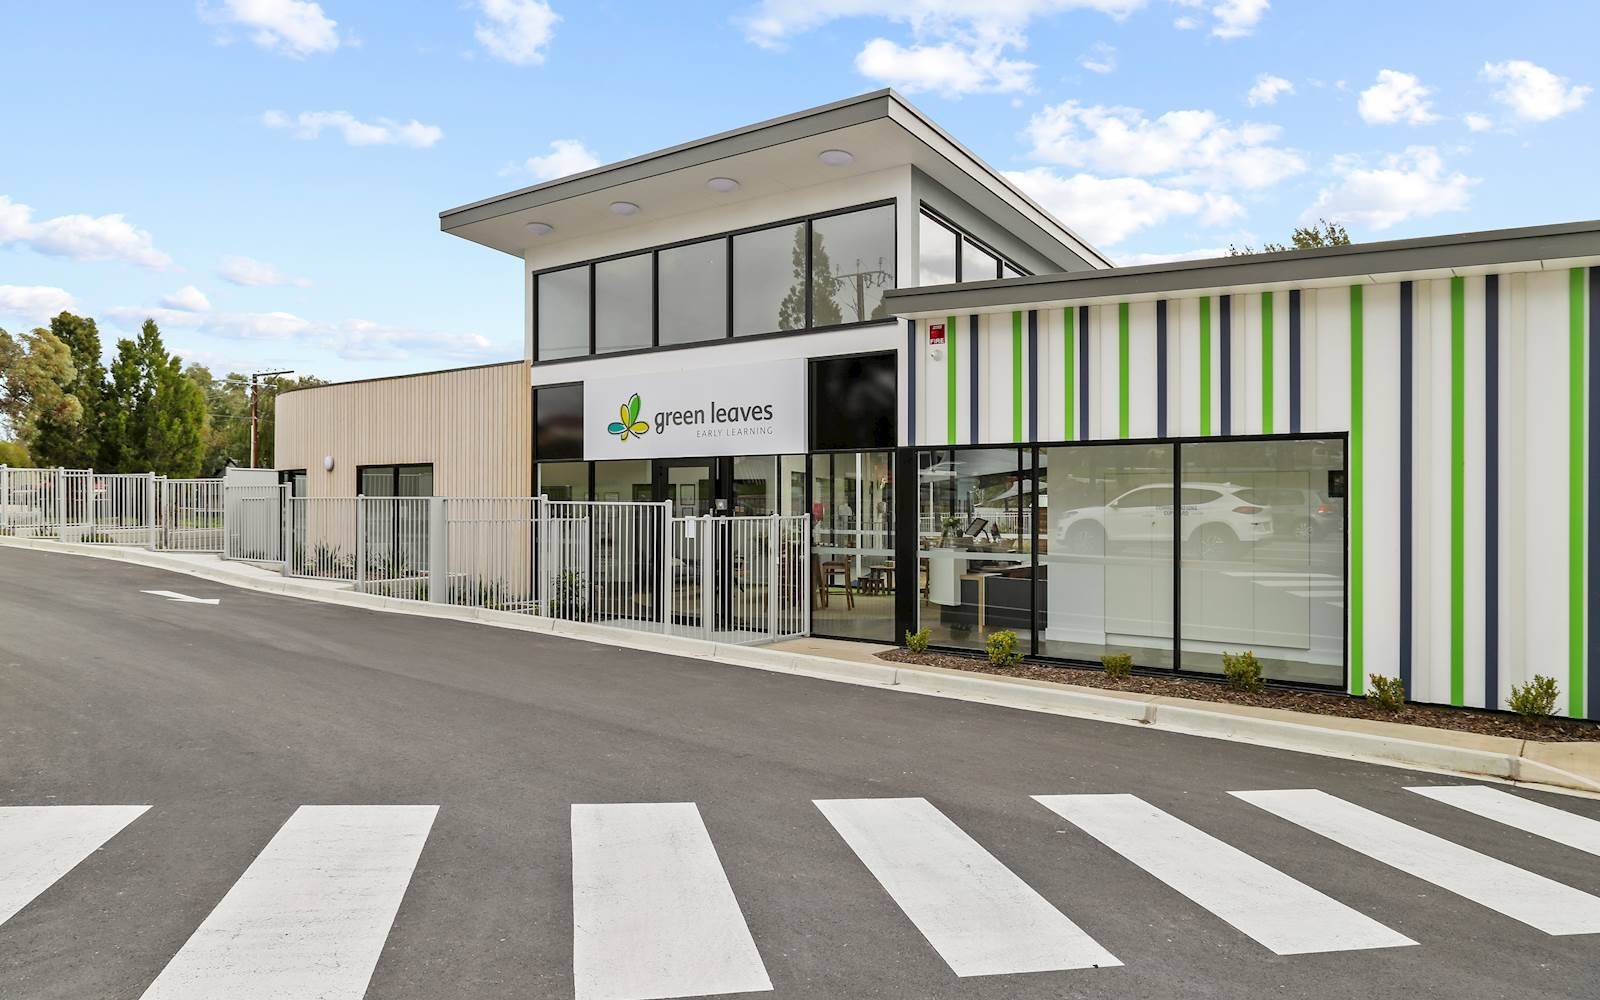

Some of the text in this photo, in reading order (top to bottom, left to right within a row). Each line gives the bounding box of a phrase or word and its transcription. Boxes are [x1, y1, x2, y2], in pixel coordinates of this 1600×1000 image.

[654, 401, 774, 435] green leaves
[696, 426, 774, 439] EARLY LEARNING
